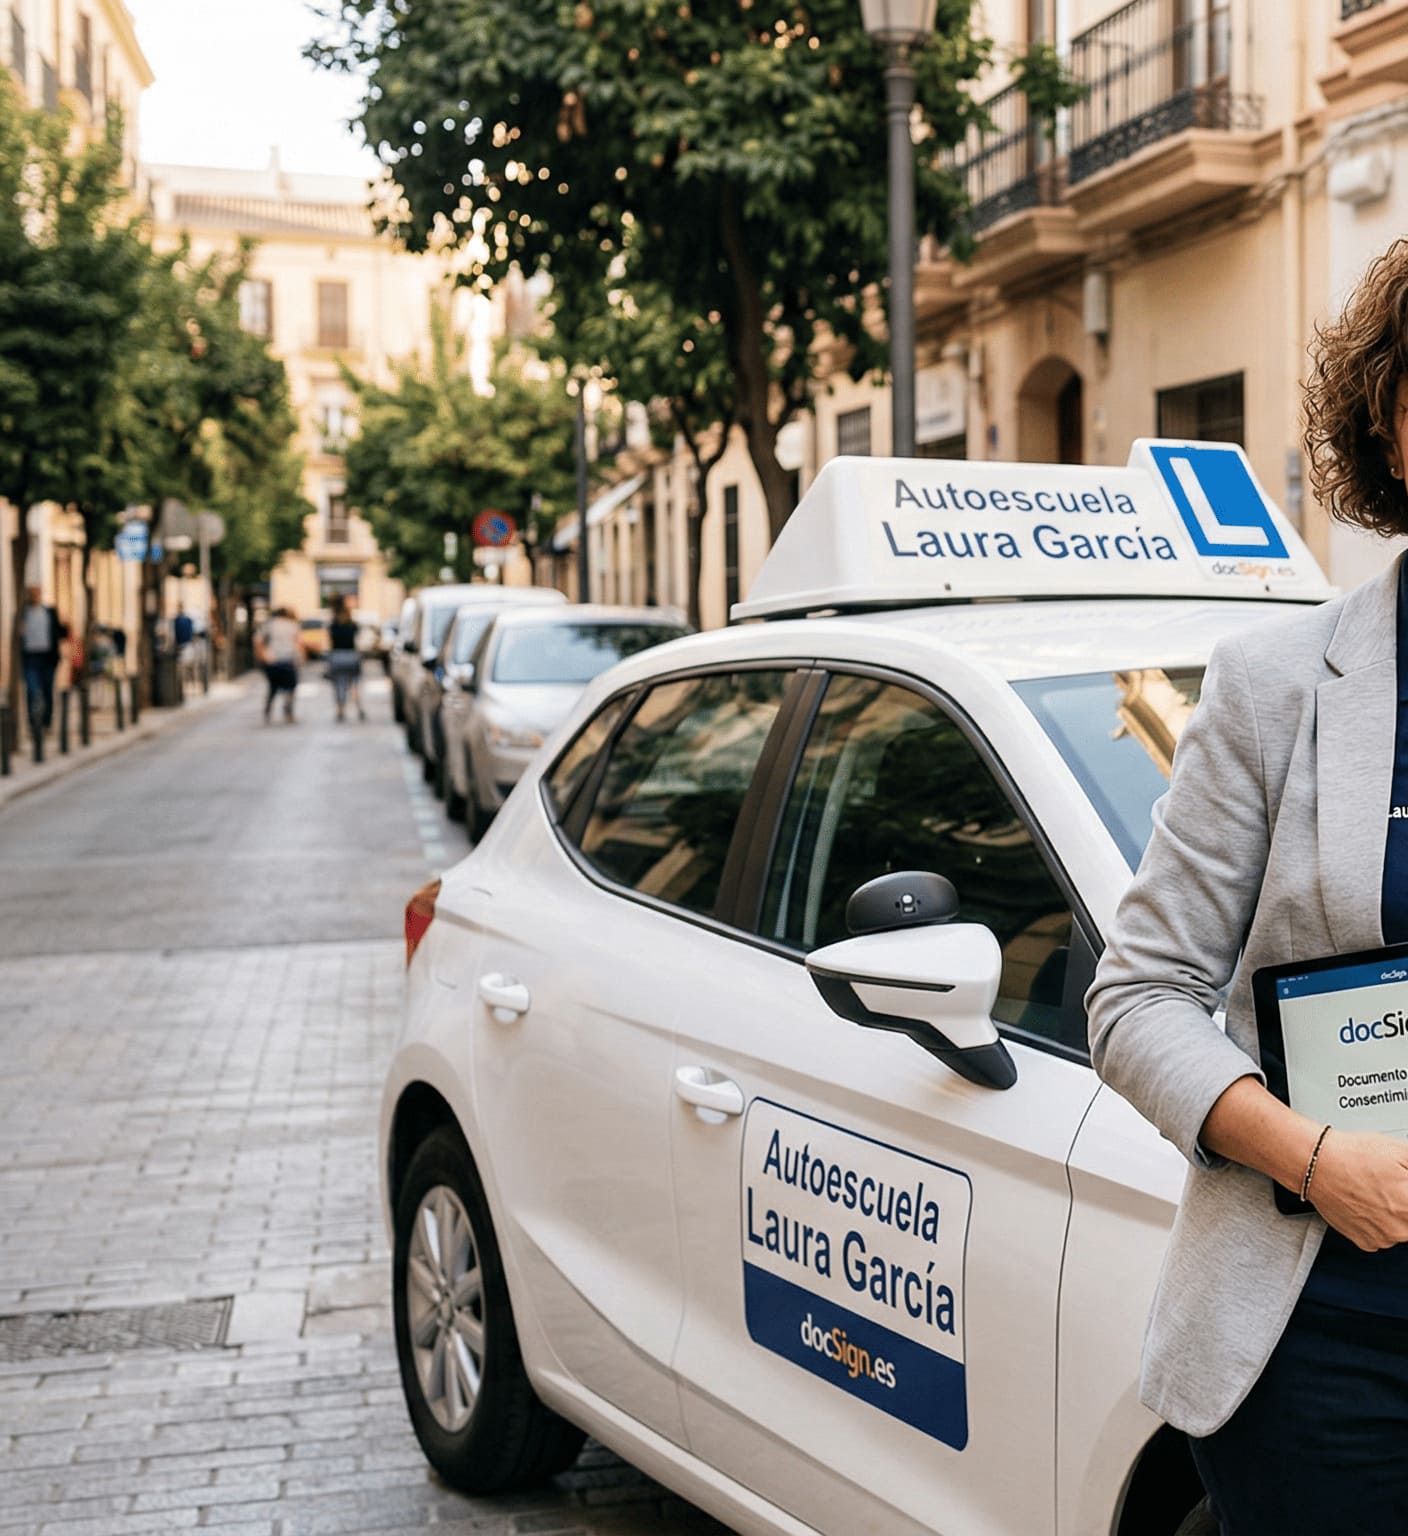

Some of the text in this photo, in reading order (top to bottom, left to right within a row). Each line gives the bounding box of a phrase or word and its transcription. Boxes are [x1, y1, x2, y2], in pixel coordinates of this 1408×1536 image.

[894, 478, 1138, 514] Autoescuela
[1169, 456, 1270, 546] L
[881, 521, 1178, 562] Laura García
[1337, 1069, 1407, 1088] Documento
[763, 1129, 940, 1244] Autoescuela
[748, 1186, 956, 1336] Laura García
[800, 1313, 897, 1389] docSign.es
